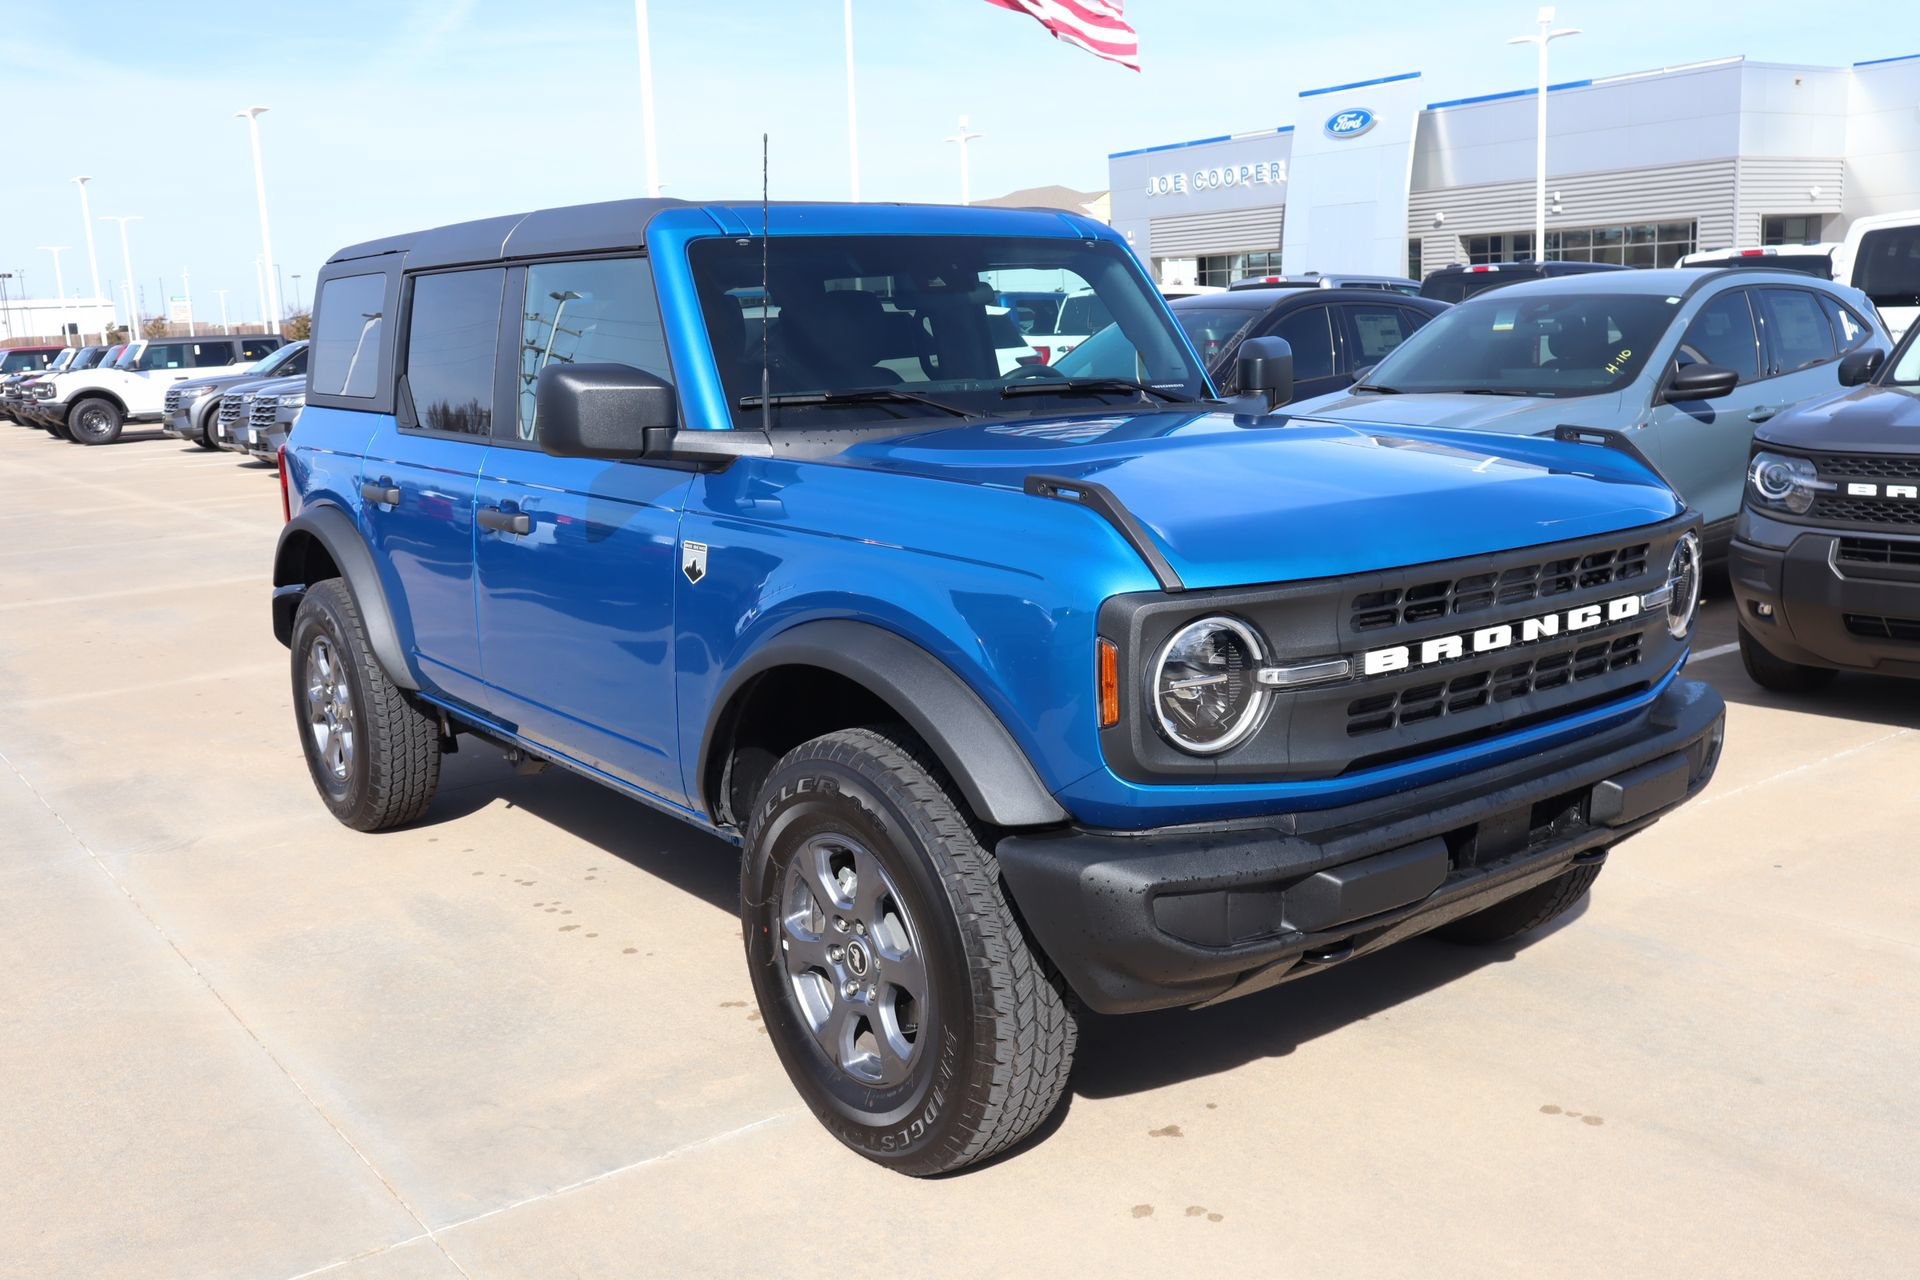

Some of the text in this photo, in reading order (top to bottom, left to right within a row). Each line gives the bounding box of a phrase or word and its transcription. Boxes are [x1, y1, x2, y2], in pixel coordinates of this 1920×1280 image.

[1333, 113, 1364, 132] Ford
[1145, 161, 1282, 195] JOE COOPER
[1364, 595, 1640, 675] BRONCO
